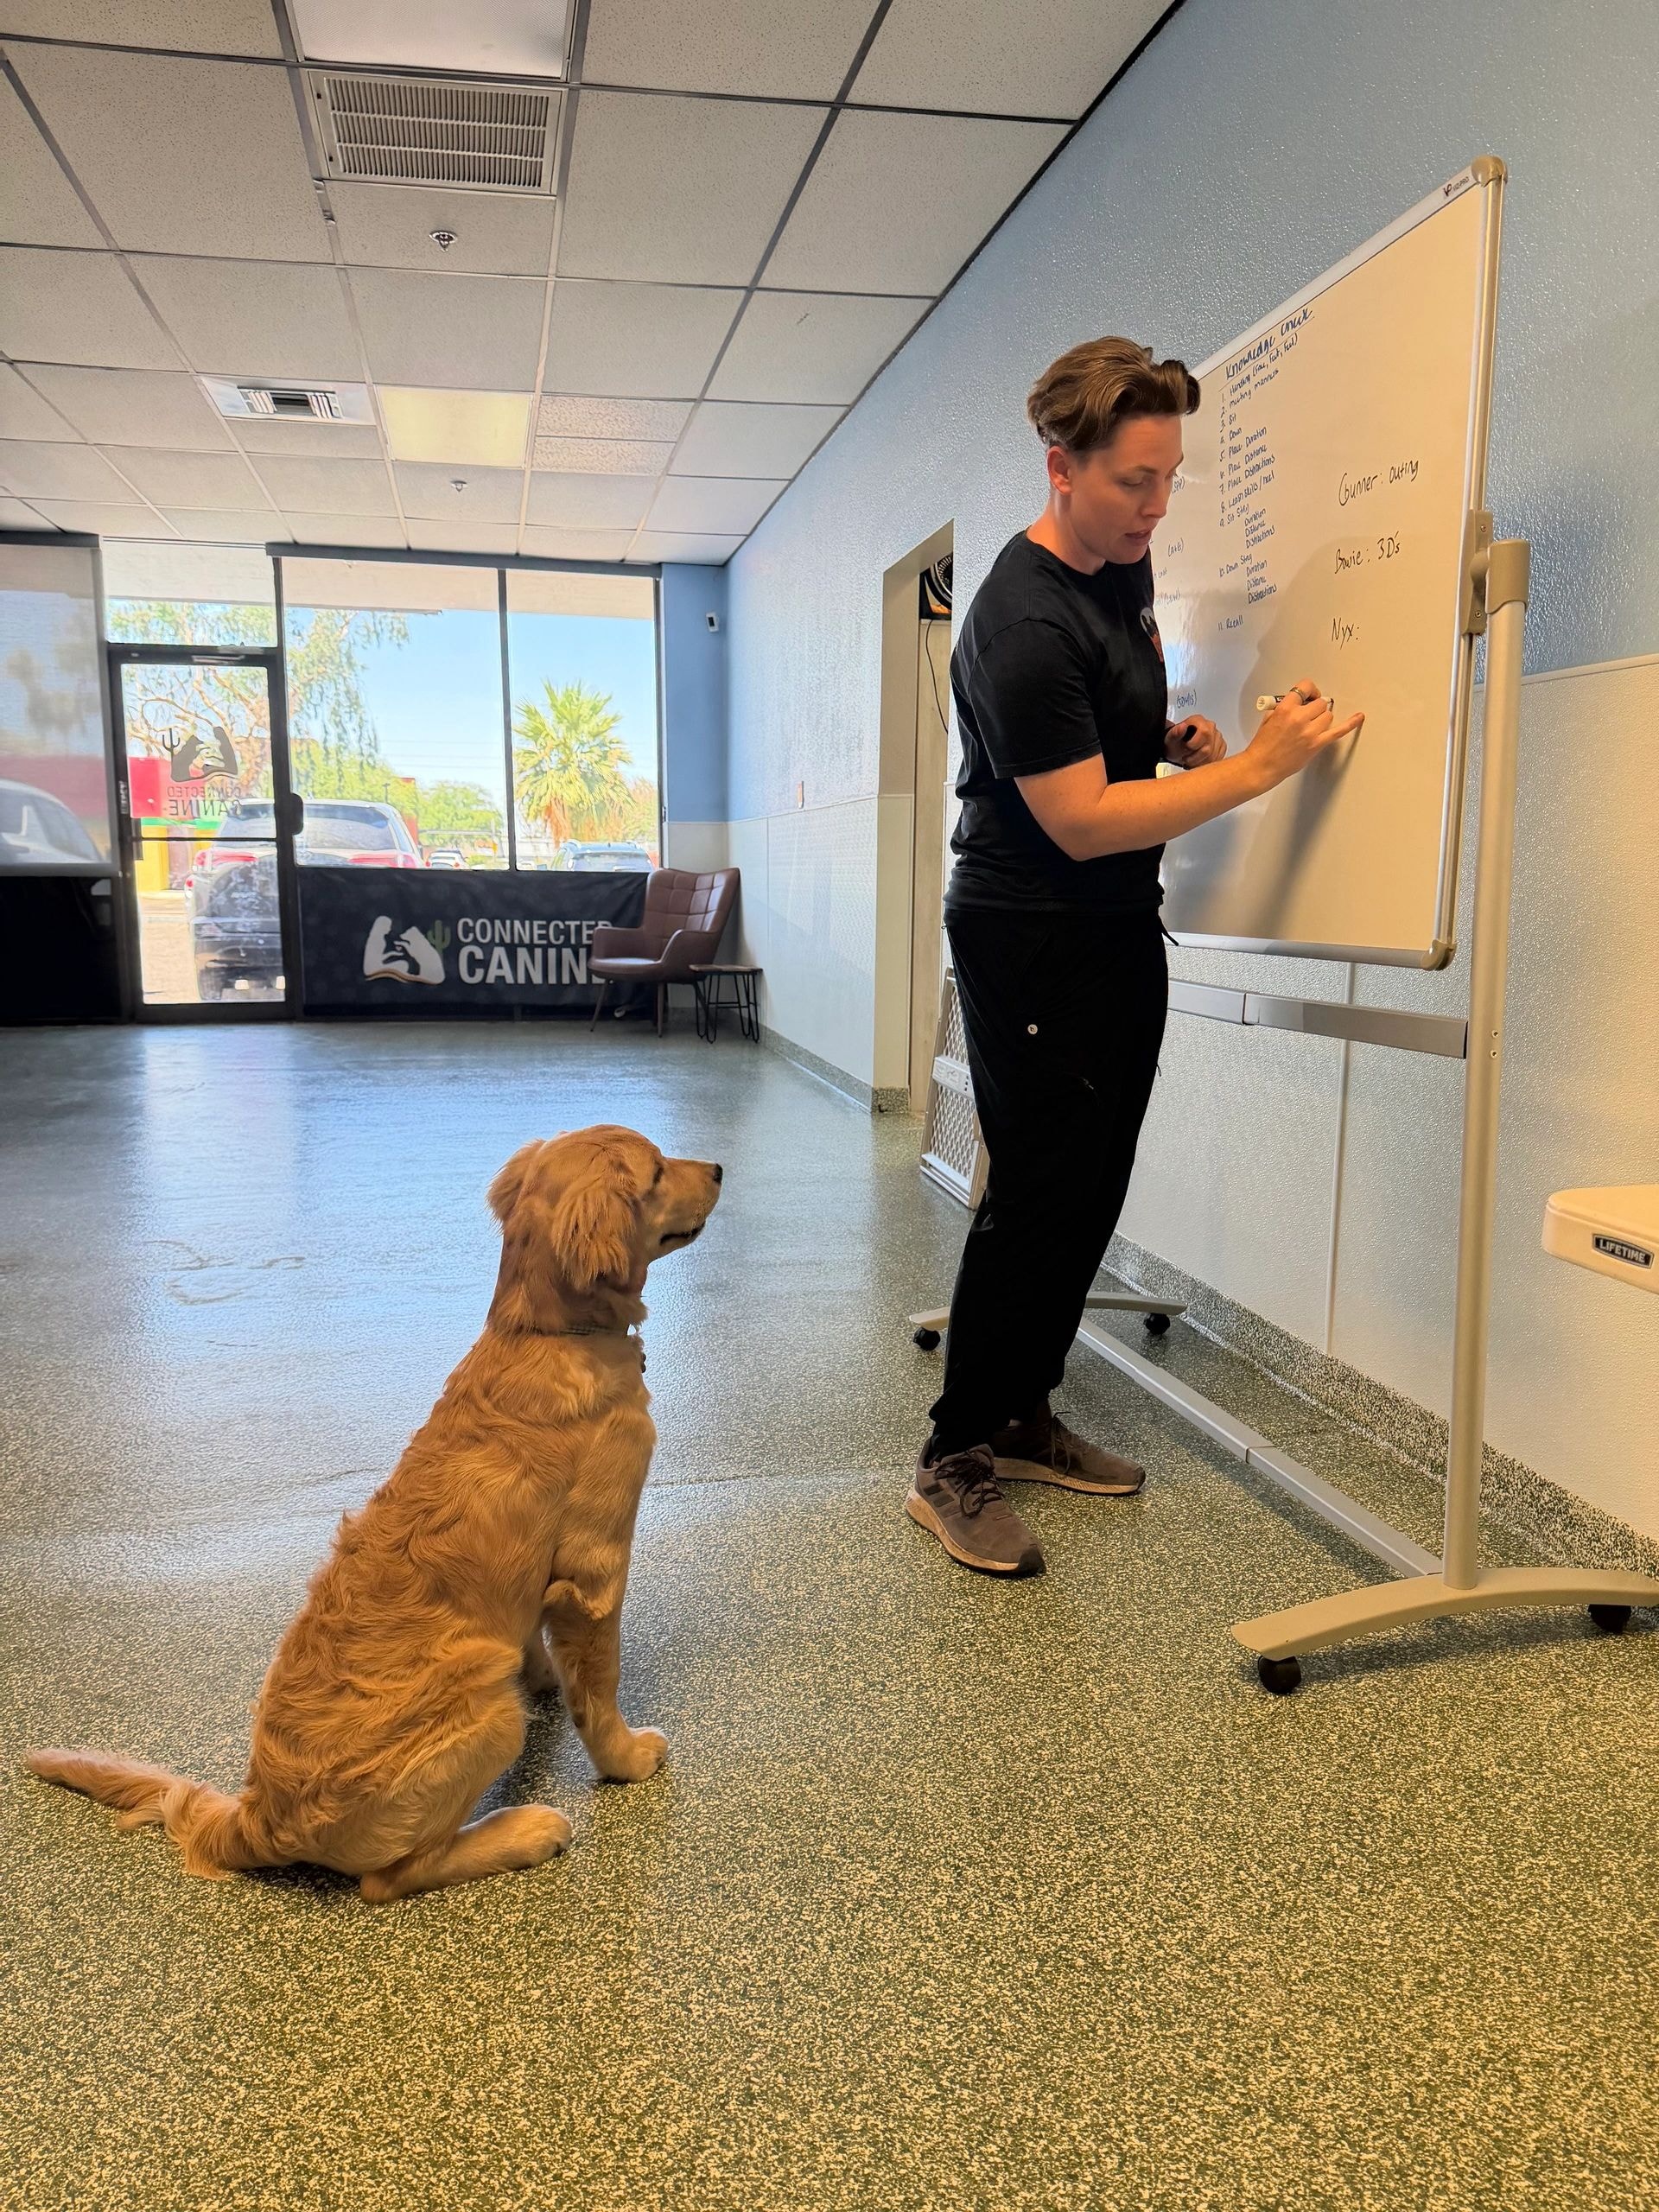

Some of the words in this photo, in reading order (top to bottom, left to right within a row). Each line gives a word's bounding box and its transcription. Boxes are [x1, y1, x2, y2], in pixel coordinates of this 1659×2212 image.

[1225, 614, 1244, 630] Recall
[1332, 617, 1360, 650] Nyx:
[457, 918, 613, 944] CONNECTE
[458, 945, 607, 985] CANIN
[1599, 1238, 1646, 1263] LIFETIME
